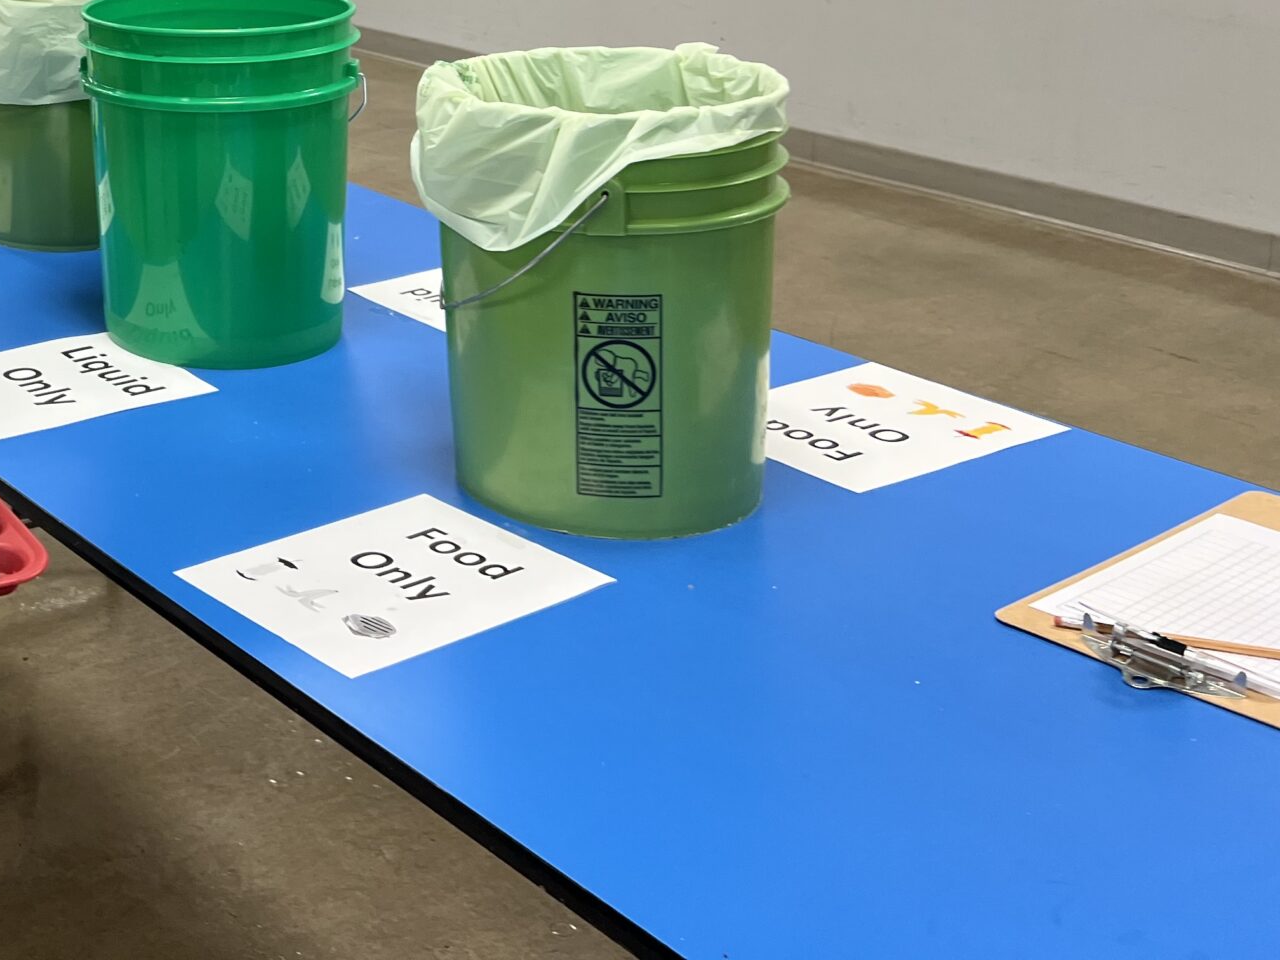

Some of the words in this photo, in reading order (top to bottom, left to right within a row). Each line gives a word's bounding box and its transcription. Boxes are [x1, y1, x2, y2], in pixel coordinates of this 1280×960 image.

[592, 298, 659, 309] WARNING
[605, 312, 647, 323] AVISO
[2, 366, 76, 406] Only
[61, 345, 166, 398] Liquid
[809, 406, 910, 443] Only
[406, 527, 525, 580] Food
[350, 551, 451, 601] Only
